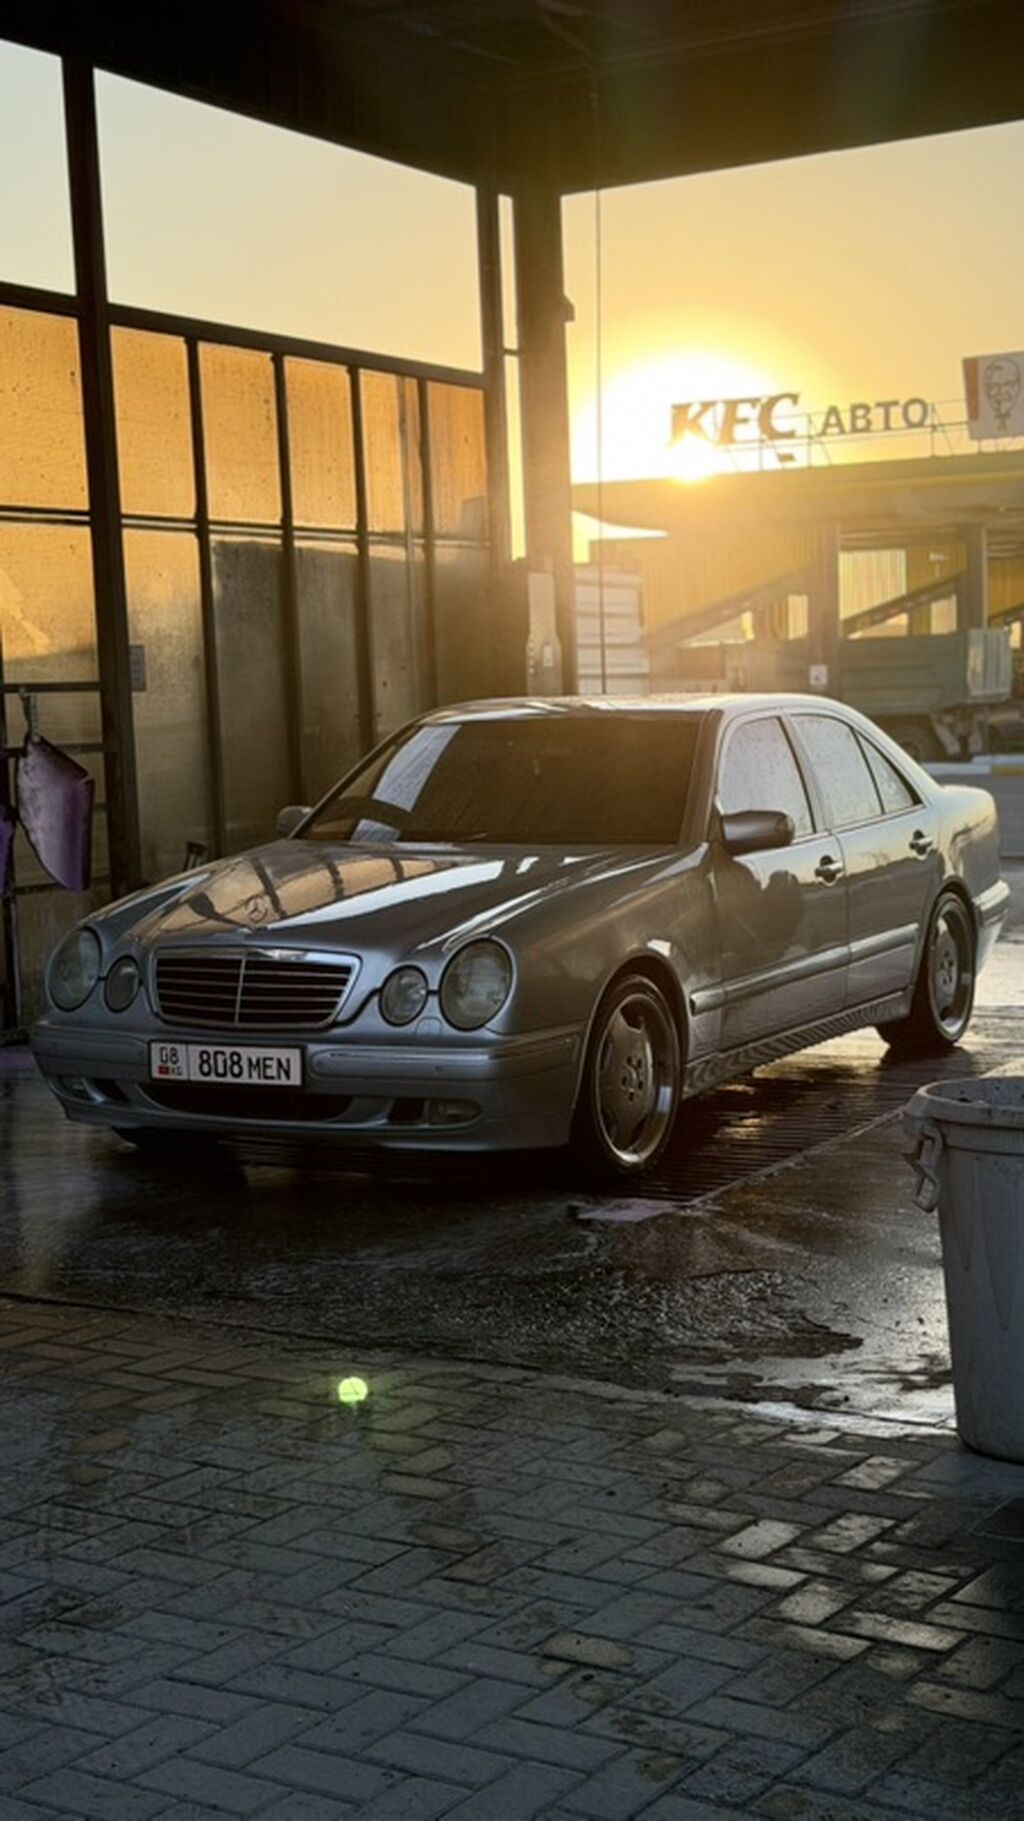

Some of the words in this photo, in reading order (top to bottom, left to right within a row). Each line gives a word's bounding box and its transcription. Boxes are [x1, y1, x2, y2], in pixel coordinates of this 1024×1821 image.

[668, 393, 801, 445] KFC
[820, 398, 929, 436] АВТО
[159, 1046, 179, 1065] 08
[199, 1050, 243, 1078] 808
[247, 1057, 291, 1081] MEN
